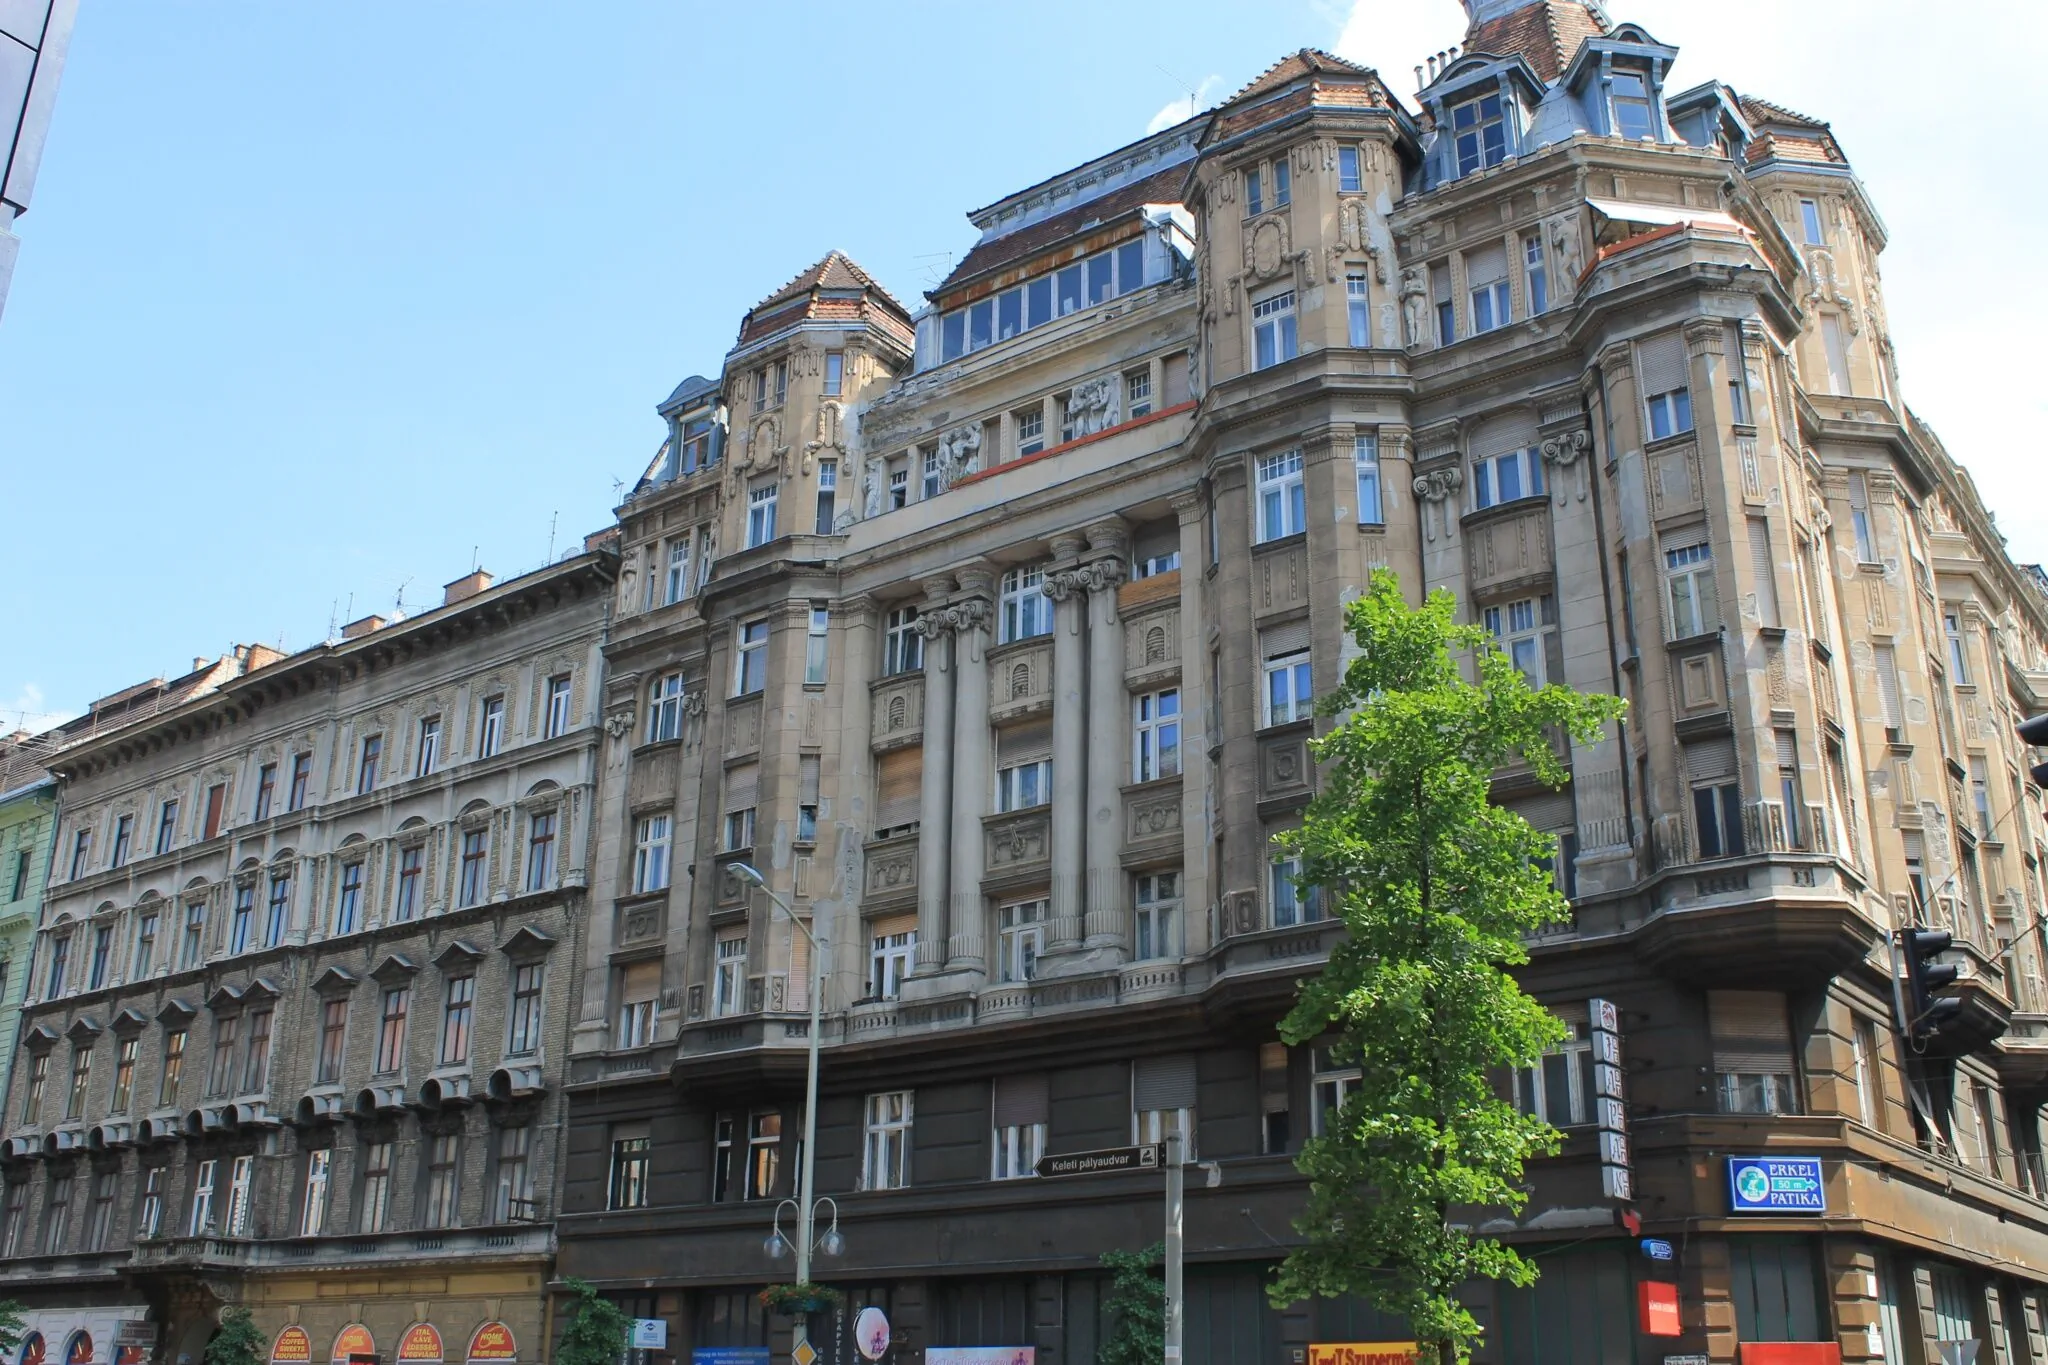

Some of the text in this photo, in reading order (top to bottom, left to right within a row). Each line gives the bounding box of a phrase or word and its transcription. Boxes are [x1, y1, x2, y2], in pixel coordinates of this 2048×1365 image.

[1052, 1155, 1129, 1172] Keleti pályaudvar
[1769, 1164, 1815, 1176] ERKEL
[1778, 1180, 1790, 1189] 50
[1770, 1192, 1821, 1205] PATIKA
[481, 1332, 504, 1341] HOME
